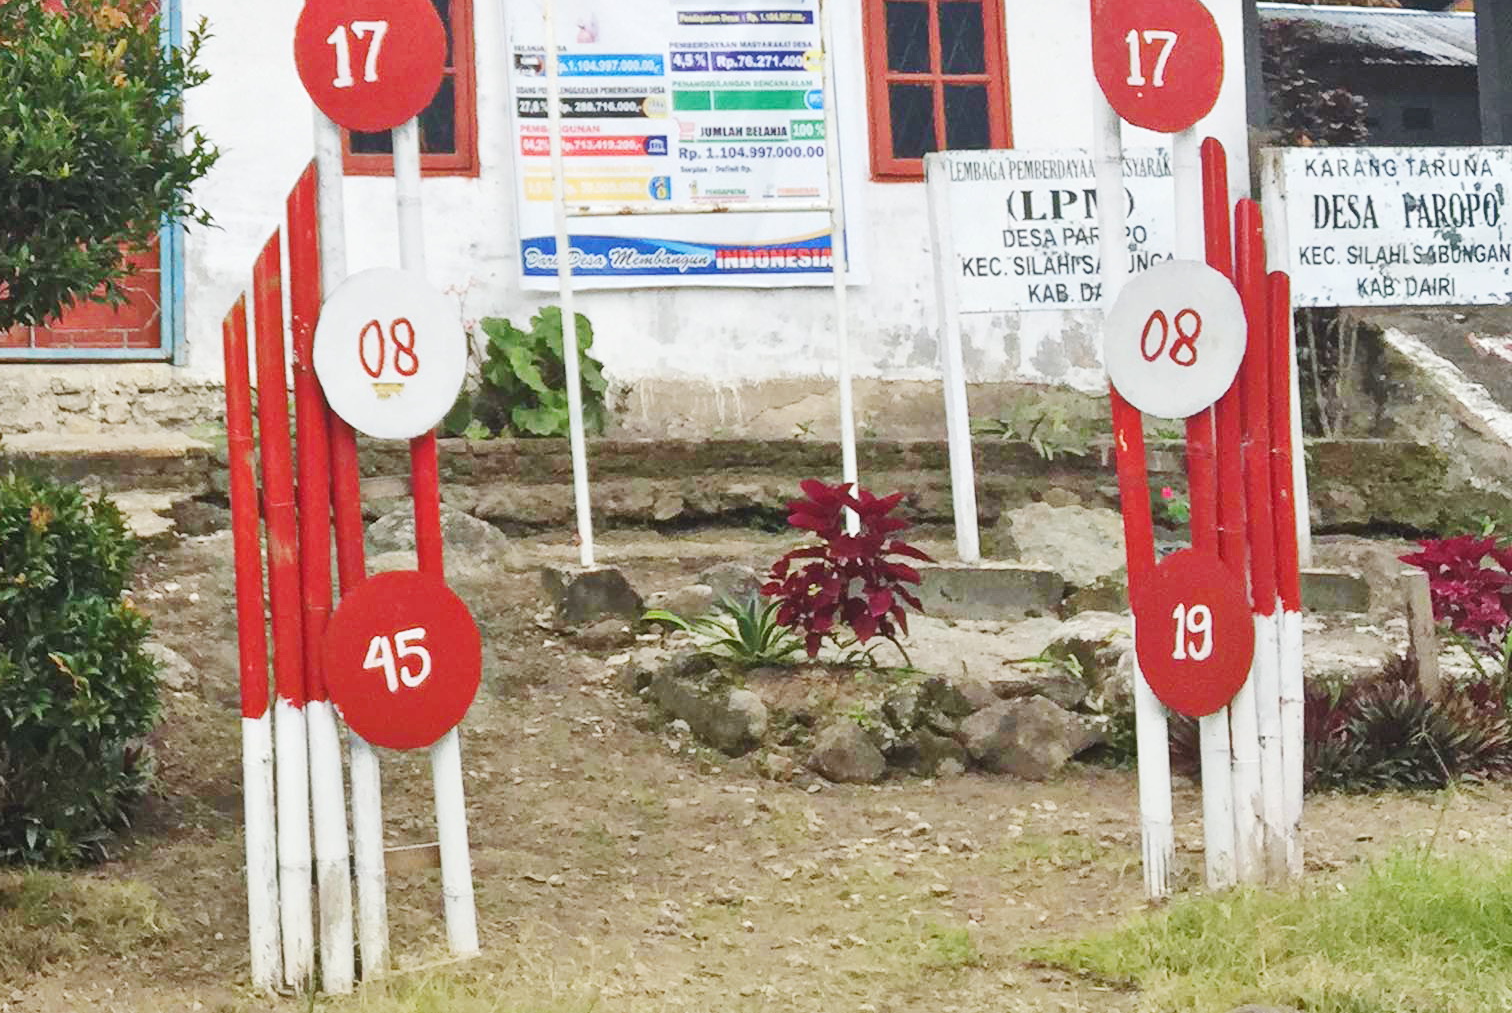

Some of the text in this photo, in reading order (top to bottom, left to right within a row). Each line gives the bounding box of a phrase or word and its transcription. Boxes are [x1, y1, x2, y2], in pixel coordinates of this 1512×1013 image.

[327, 20, 388, 88] 17
[1125, 29, 1178, 87] 17
[701, 126, 743, 137] JUMLAH
[746, 127, 787, 137] BELANJA
[679, 147, 701, 161] Rp.
[950, 161, 1006, 182] LEMBAGA
[1009, 159, 1095, 180] PEMBERDAYAA
[1305, 158, 1493, 177] KARANG TARUNA
[1314, 192, 1499, 229] DESA PAROPO
[1003, 228, 1056, 247] DESA
[568, 247, 607, 269] Desa
[609, 247, 712, 273] Membangun
[716, 249, 834, 269] INDONESIA
[962, 256, 1008, 276] KEC.
[1014, 254, 1075, 275] SILAHI
[1299, 246, 1340, 265] KEC.
[1028, 284, 1074, 303] KAB.
[1406, 277, 1455, 297] DAIRI
[359, 317, 419, 378] 08
[1140, 308, 1202, 367] 08
[1171, 603, 1213, 661] 19
[362, 627, 432, 693] 45
